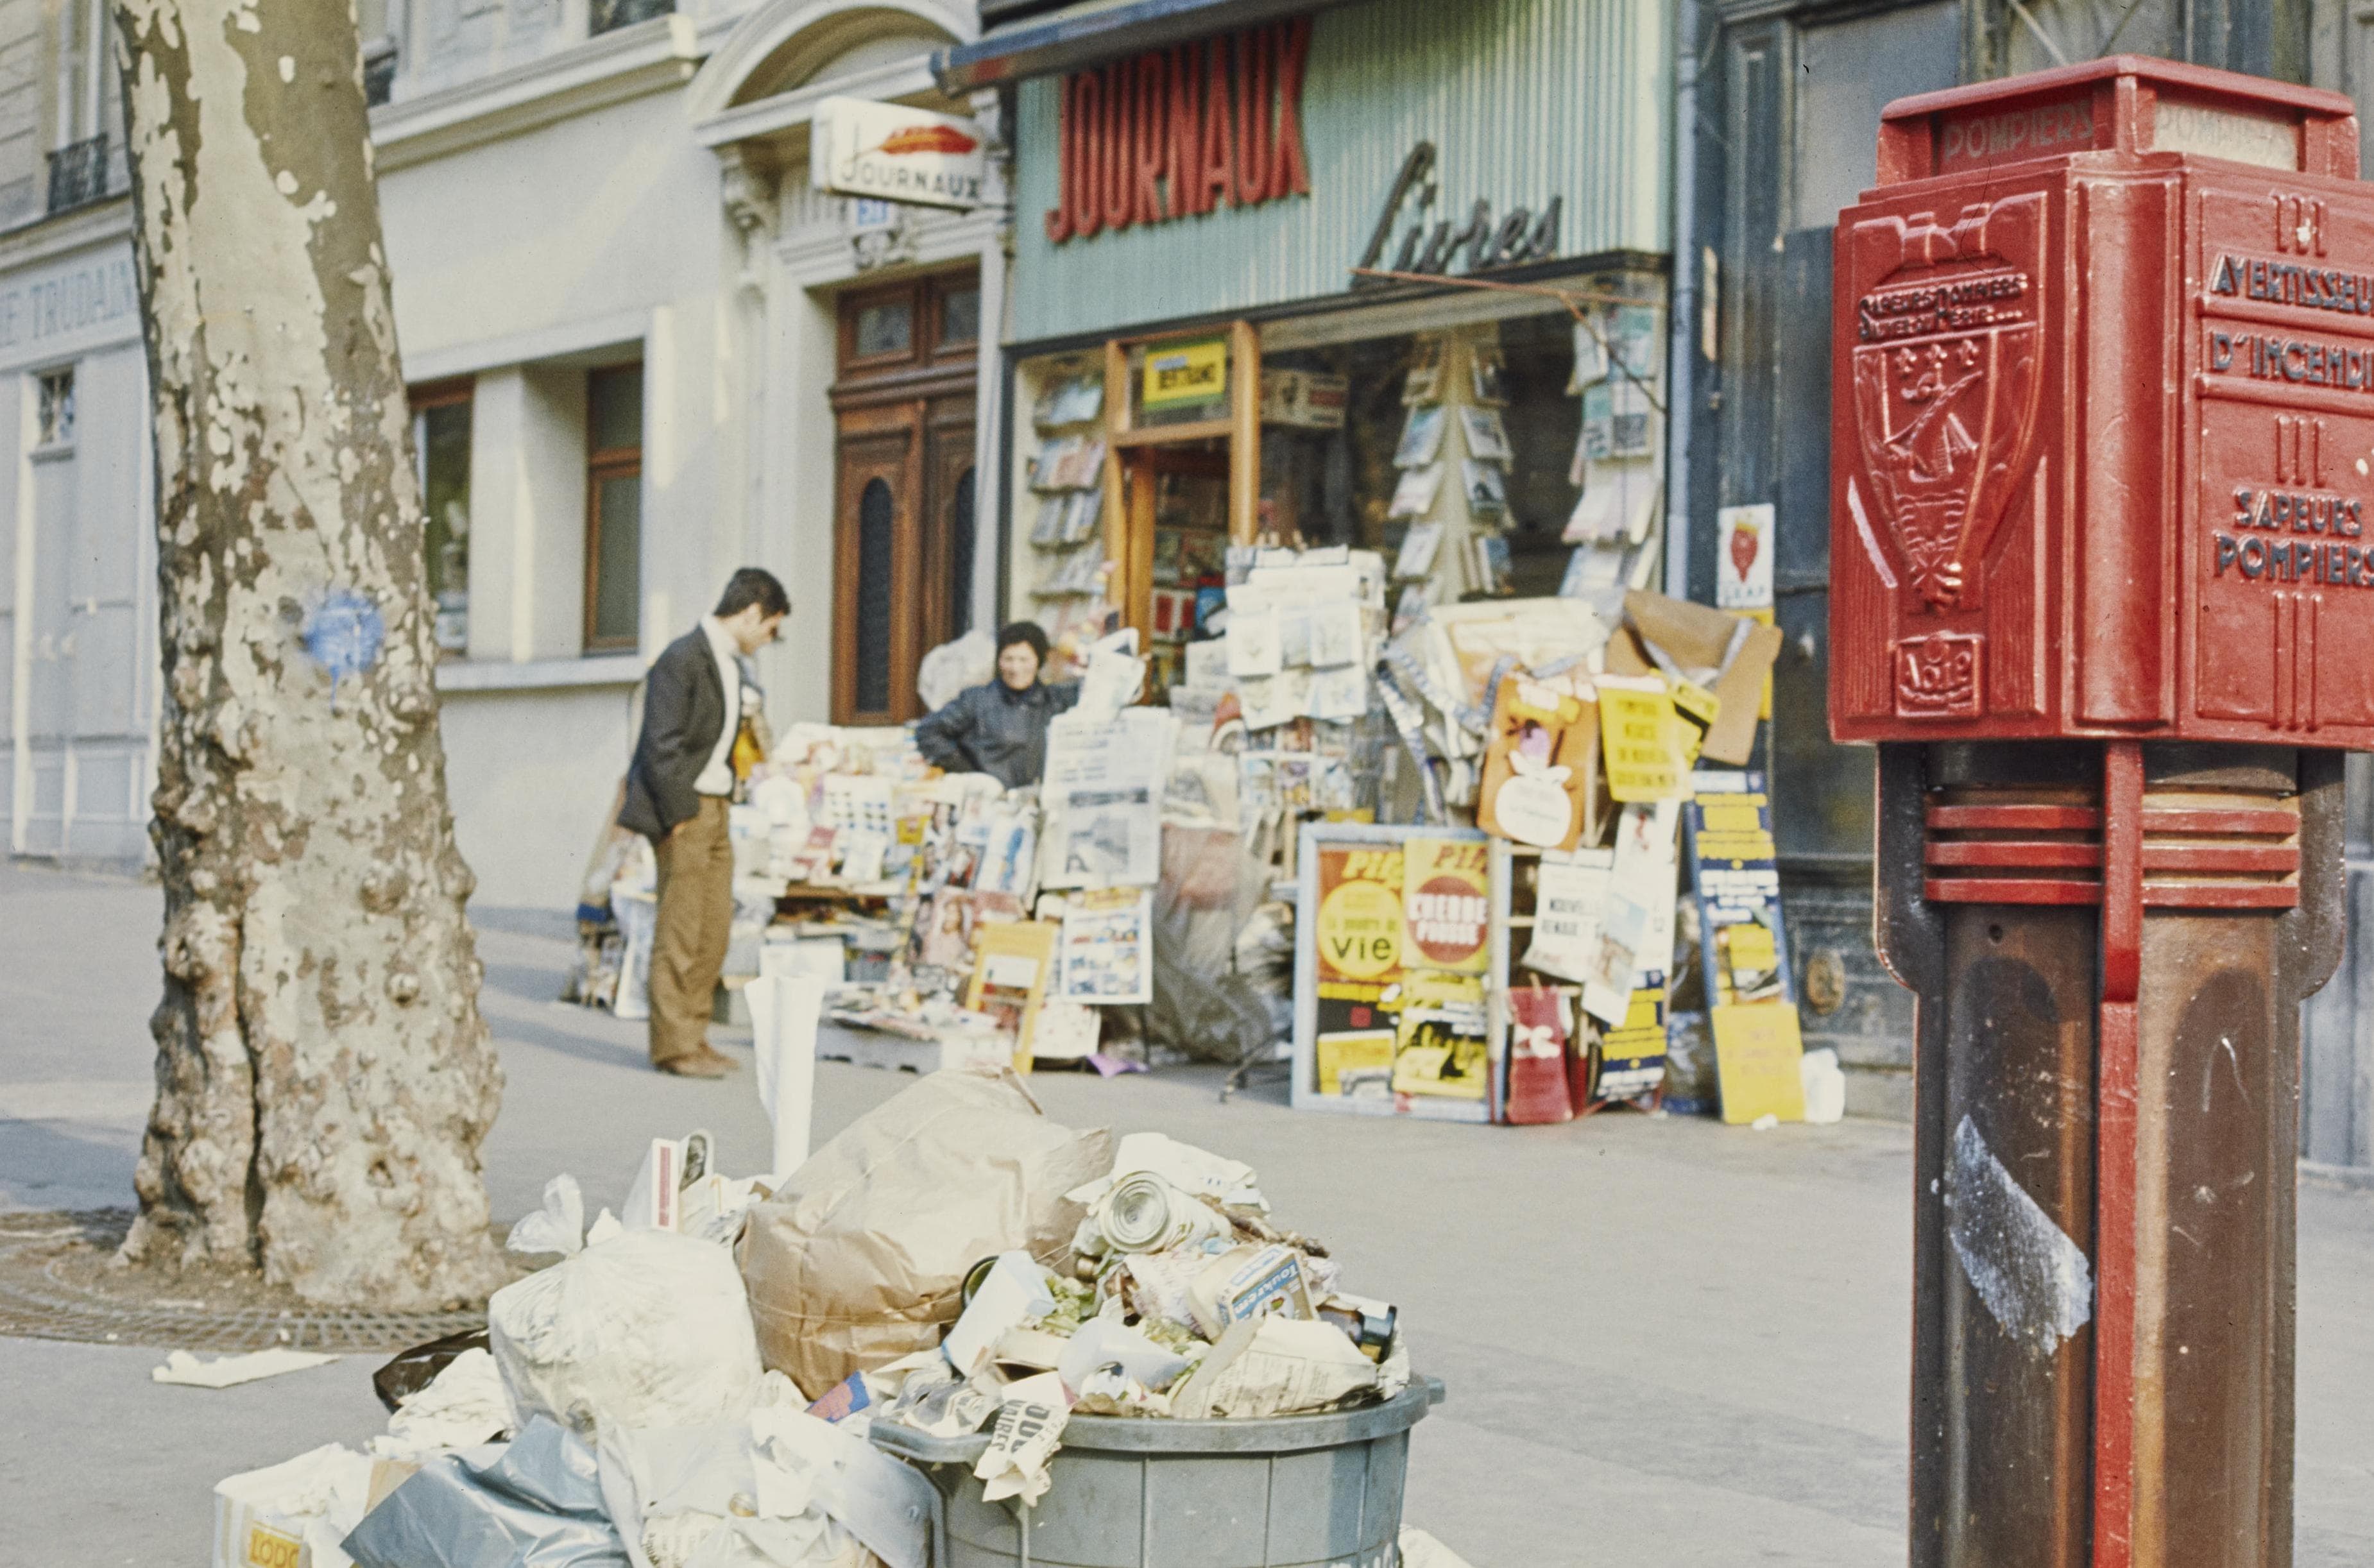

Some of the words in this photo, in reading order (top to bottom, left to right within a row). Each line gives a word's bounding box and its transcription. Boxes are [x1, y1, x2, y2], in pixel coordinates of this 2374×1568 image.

[1045, 16, 1311, 244] JOURNAUX
[1943, 99, 2093, 160] POMPIERS
[841, 127, 980, 199] JOURNAUX
[1349, 141, 1563, 292] Livres
[2210, 254, 2374, 317] AVERTISSEU
[2210, 331, 2374, 393] D'INCENDI
[2233, 489, 2363, 538] SAPEURS
[2212, 530, 2374, 589] POMPIERS
[1331, 935, 1392, 961] vie
